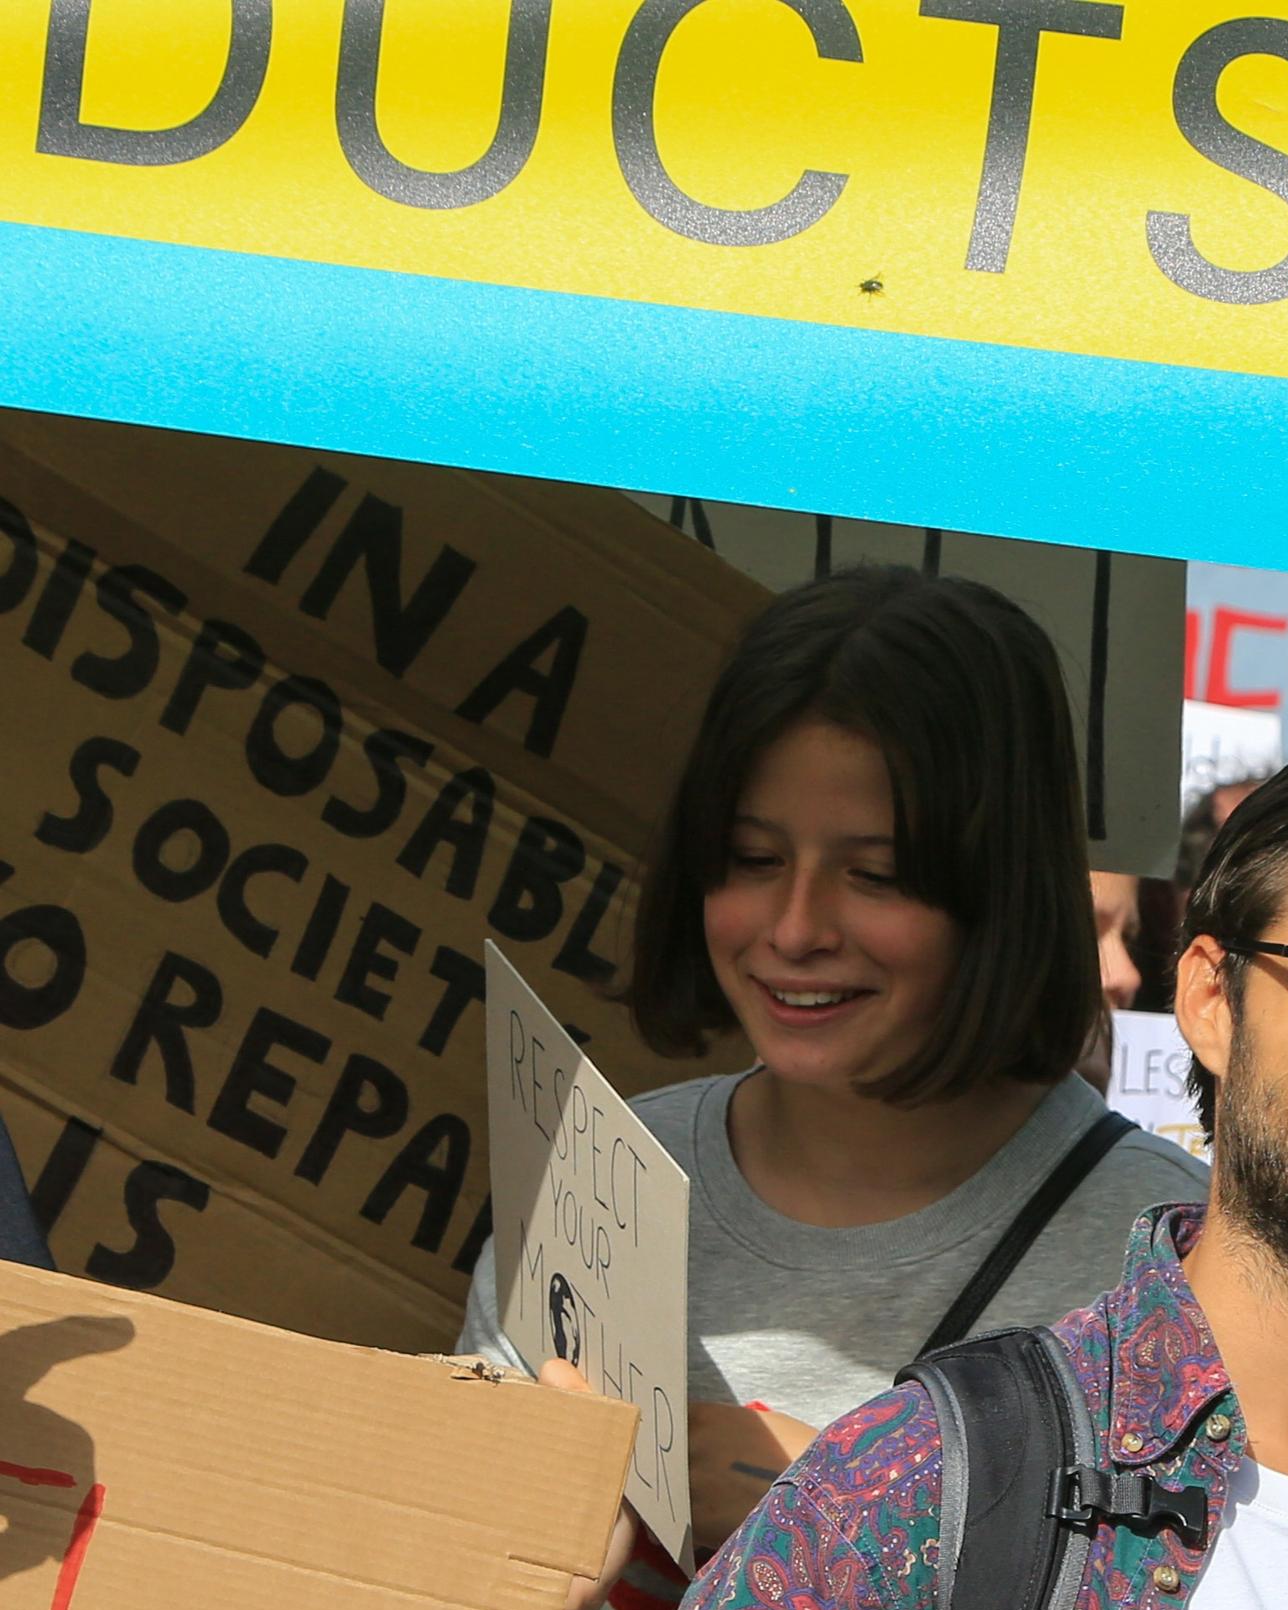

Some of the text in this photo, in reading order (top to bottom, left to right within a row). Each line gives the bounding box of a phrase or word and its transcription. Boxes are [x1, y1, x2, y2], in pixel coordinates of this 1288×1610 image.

[242, 465, 477, 680] IN
[453, 604, 590, 760] A
[0, 496, 626, 984] ISPOSABL
[0, 859, 87, 1031] O
[33, 736, 591, 1058] SOCIET
[28, 1115, 210, 1289] IS
[510, 1008, 647, 1248] RESPECT
[549, 1160, 611, 1300] YOUR
